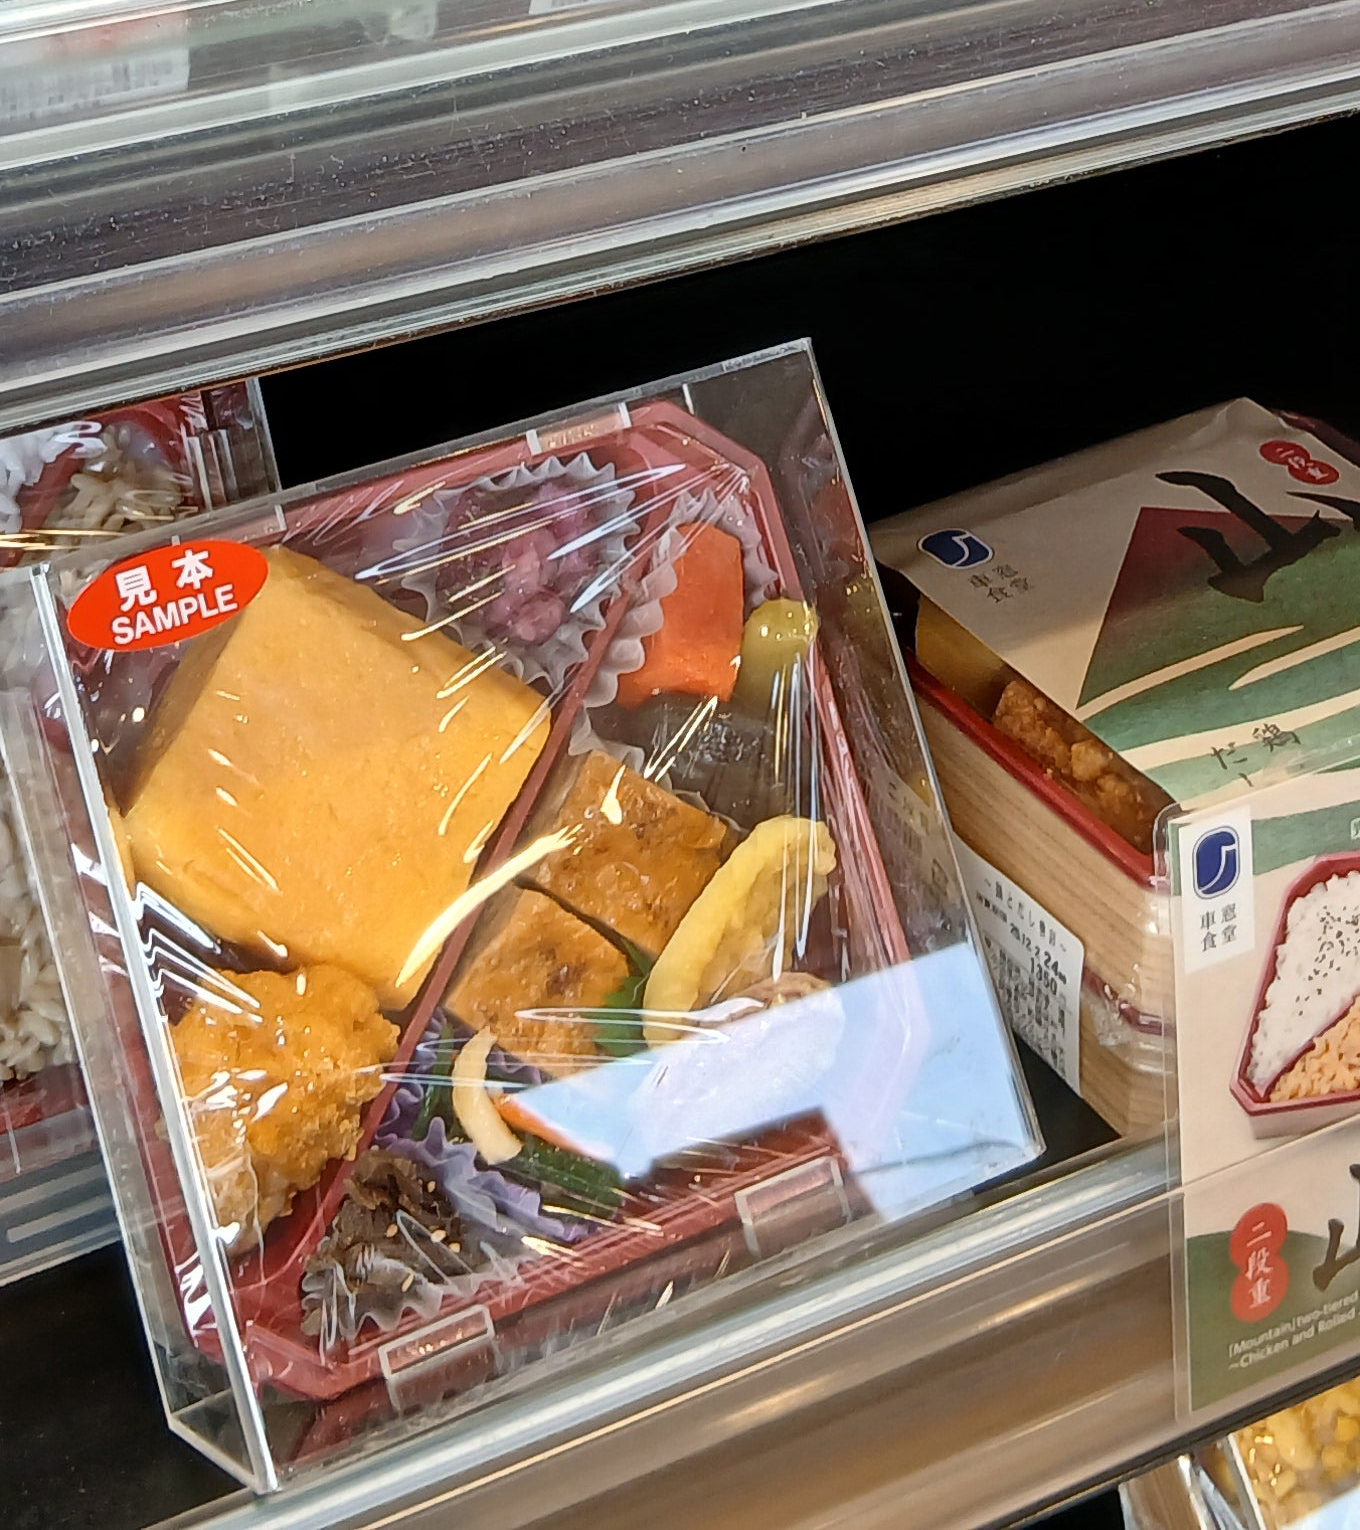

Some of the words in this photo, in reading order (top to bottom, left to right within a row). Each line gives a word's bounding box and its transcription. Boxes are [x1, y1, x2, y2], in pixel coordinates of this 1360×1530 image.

[115, 548, 214, 612] 見本
[111, 583, 239, 646] SAMPLE
[1245, 1221, 1275, 1310] 二段重
[1292, 1326, 1315, 1346] and
[1318, 1307, 1357, 1334] Rolled
